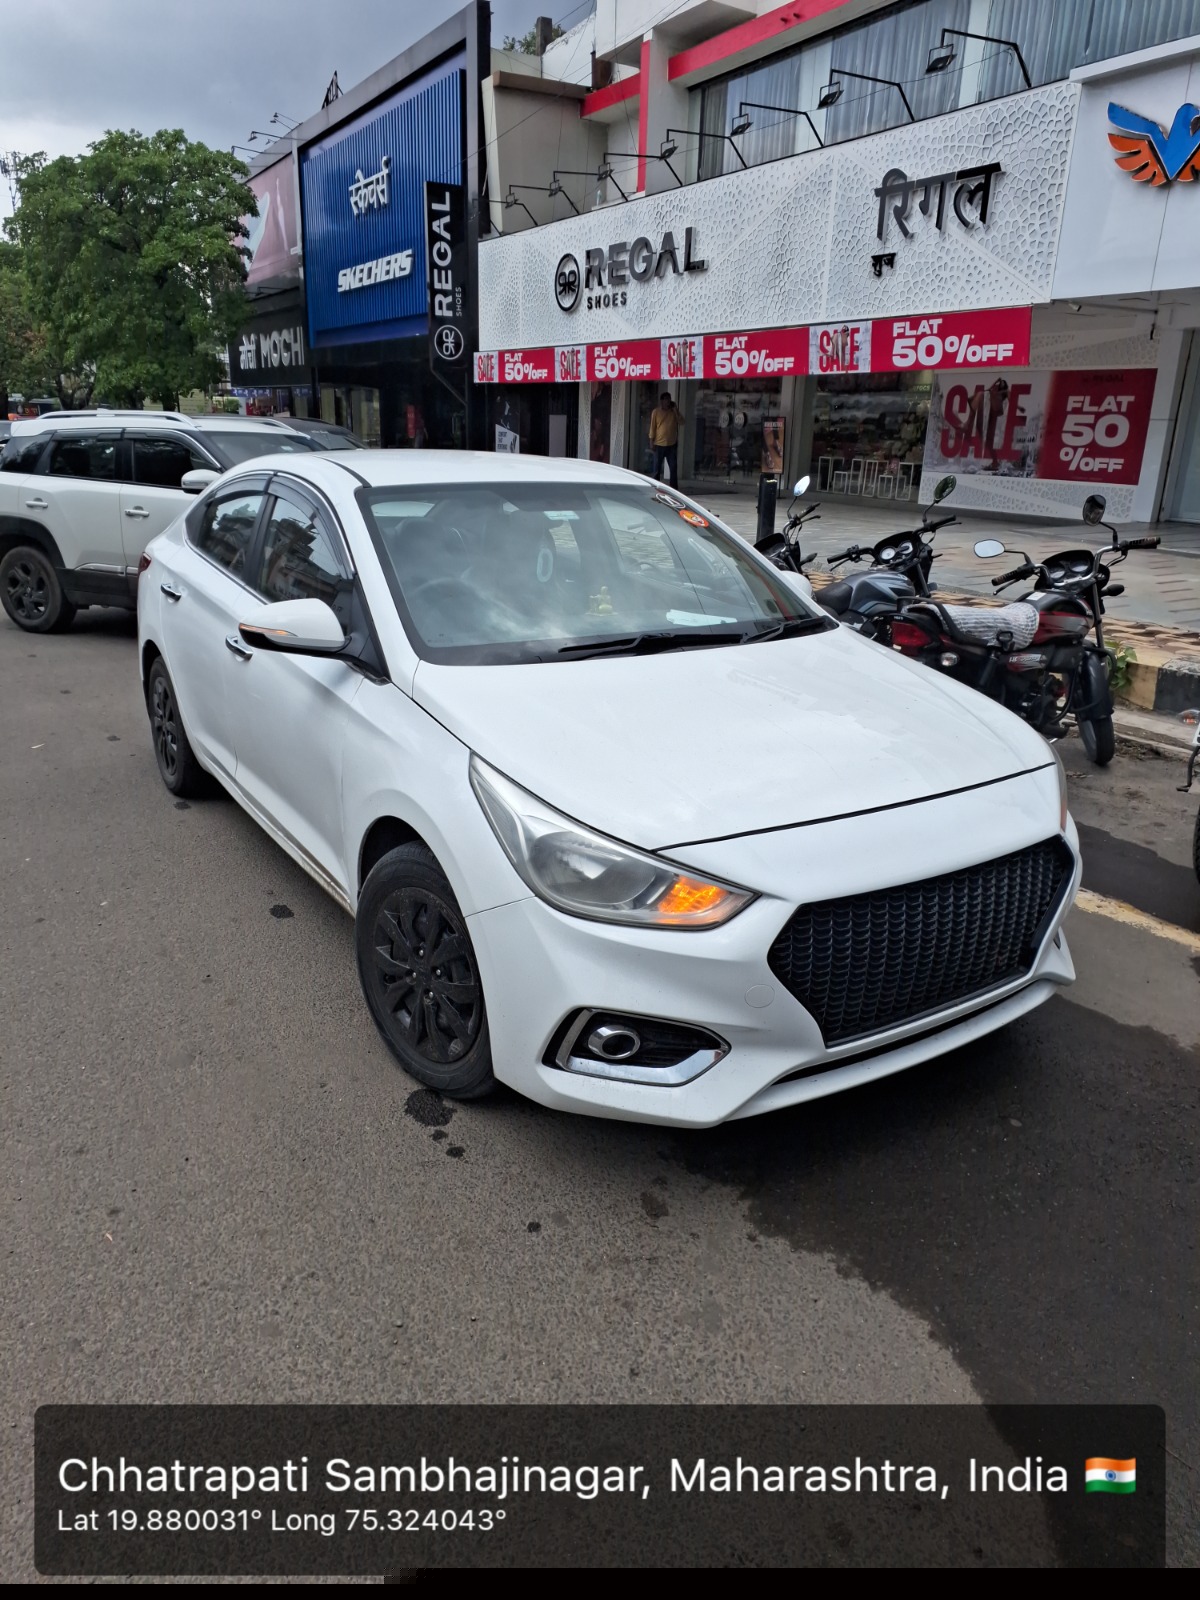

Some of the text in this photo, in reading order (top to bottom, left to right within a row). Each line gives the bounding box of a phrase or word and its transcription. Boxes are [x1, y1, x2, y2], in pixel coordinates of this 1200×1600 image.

[348, 155, 391, 216] स्केचर्स
[874, 161, 1004, 241] रिगल
[337, 248, 413, 293] SKECHERS
[431, 191, 453, 317] REGAL
[585, 226, 709, 289] REGAL
[454, 286, 463, 317] SHOES
[586, 291, 628, 310] SHOES
[714, 336, 748, 350] FLAT
[893, 318, 943, 337] FLAT
[260, 326, 305, 368] MOCHI
[504, 353, 523, 363] FLAT
[594, 346, 618, 357] FLAT
[667, 341, 696, 378] SALE
[819, 327, 861, 373] SALE
[940, 383, 1032, 461] SALE
[1066, 395, 1135, 412] FLAT
[1061, 414, 1130, 447] 50
